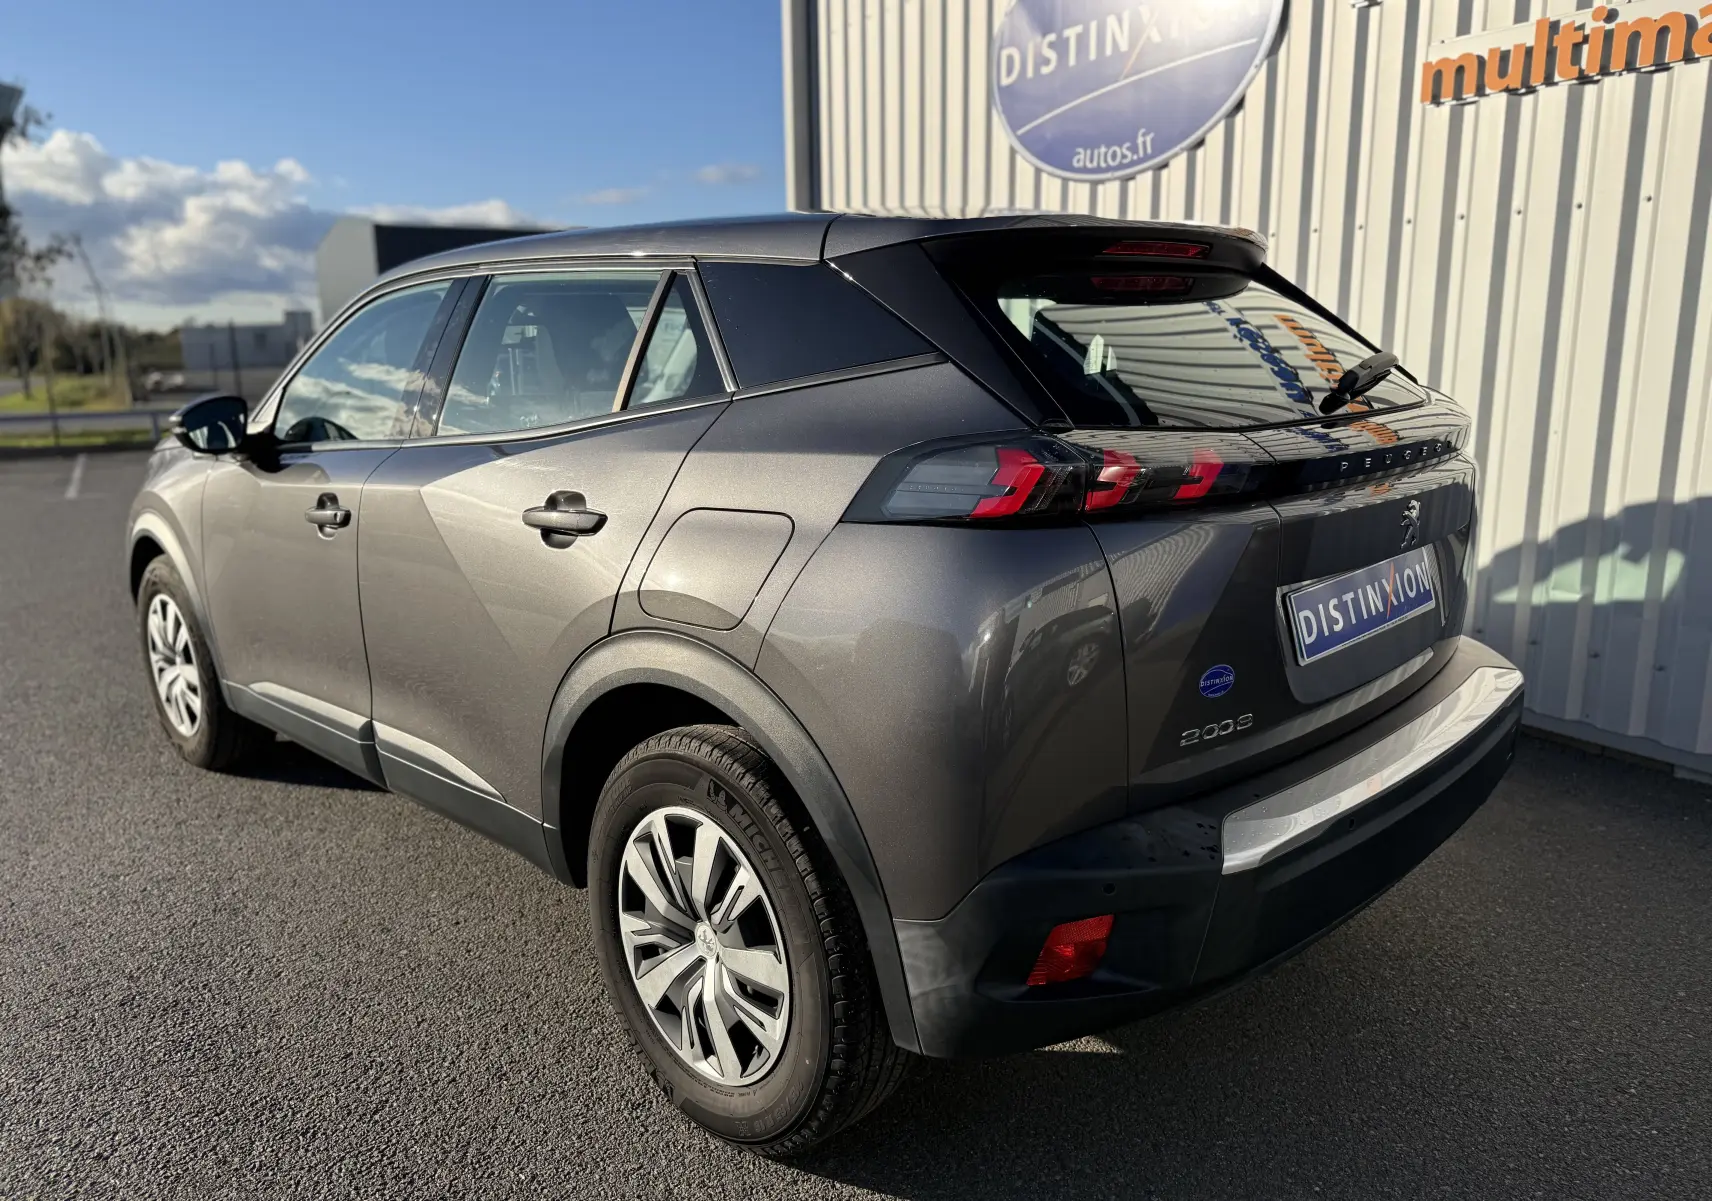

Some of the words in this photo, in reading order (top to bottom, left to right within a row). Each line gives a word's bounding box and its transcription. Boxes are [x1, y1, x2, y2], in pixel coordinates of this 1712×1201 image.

[1072, 128, 1155, 169] autos.fr
[1299, 561, 1430, 646] DISTINXION
[1180, 713, 1253, 747] 2008
